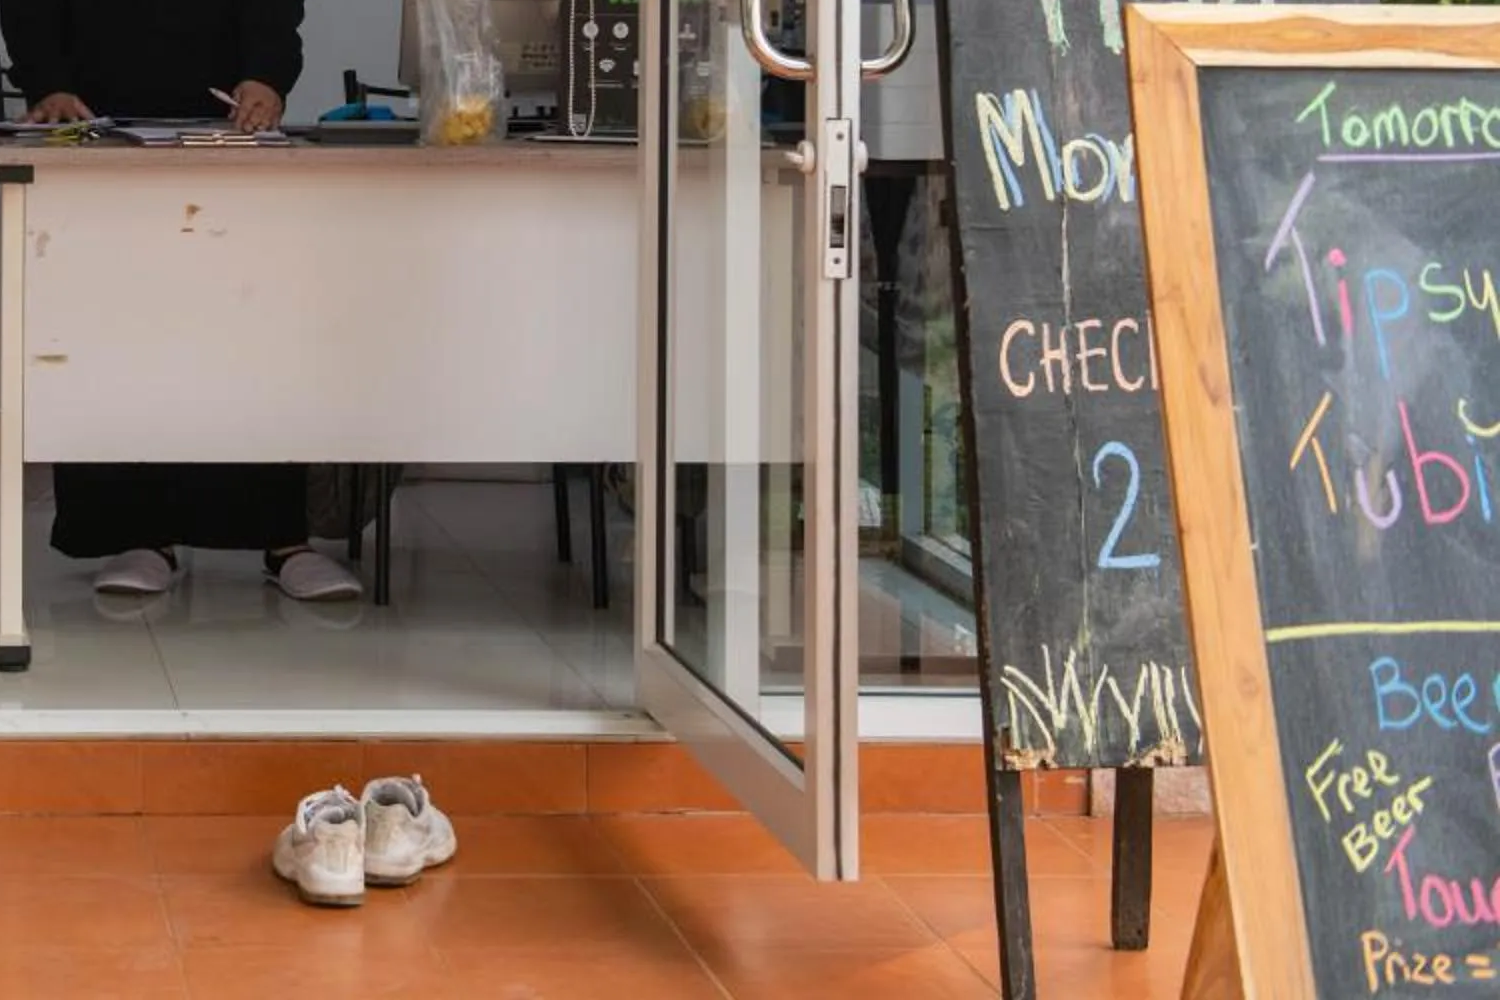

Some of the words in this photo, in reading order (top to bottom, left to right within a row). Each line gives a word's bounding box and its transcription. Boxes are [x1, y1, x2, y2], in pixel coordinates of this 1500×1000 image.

[1263, 171, 1500, 437] Tipsy
[999, 309, 1159, 397] CHEC
[1092, 440, 1161, 570] 2
[1369, 656, 1500, 734] Bee
[1305, 737, 1400, 823] Free
[1341, 775, 1433, 873] Beer
[1360, 928, 1457, 994] Prize
